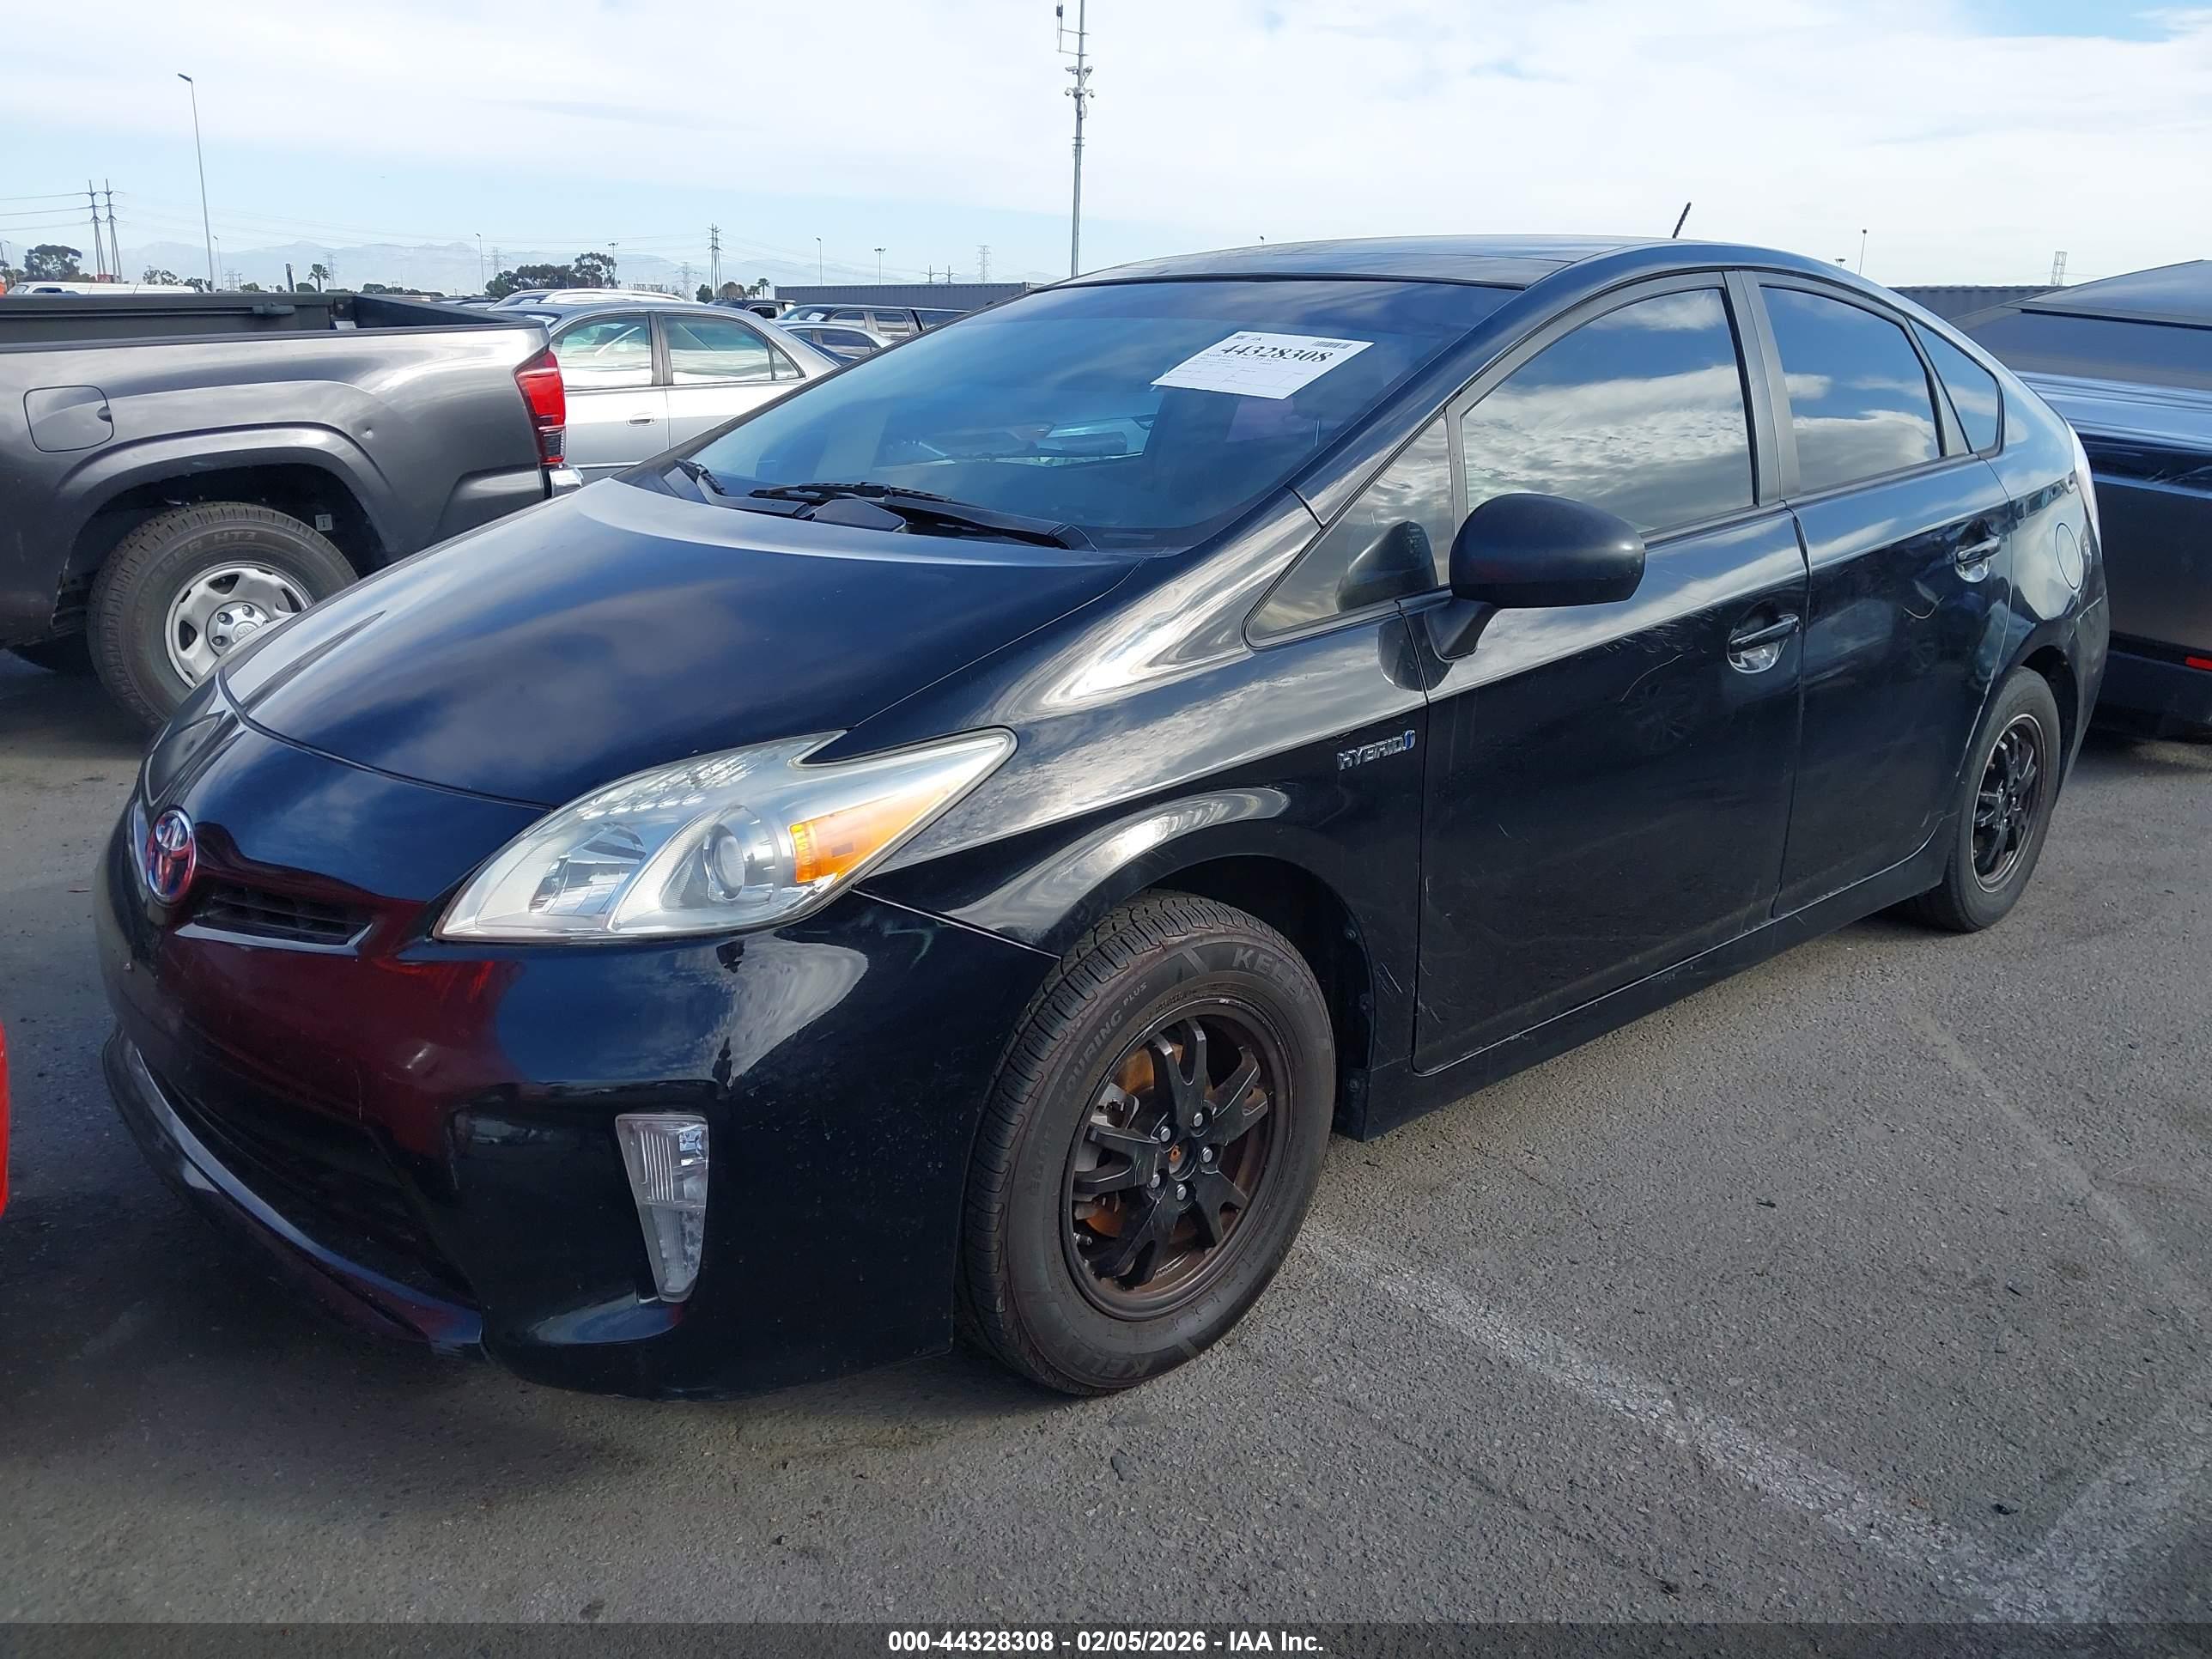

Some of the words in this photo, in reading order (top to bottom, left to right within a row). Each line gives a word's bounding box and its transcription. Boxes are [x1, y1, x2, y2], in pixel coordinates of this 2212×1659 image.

[1221, 343, 1334, 363] 44328308
[213, 530, 258, 543] HT3
[1336, 736, 1404, 771] HYBRID
[1231, 946, 1311, 1005] KELLY
[1056, 1009, 1123, 1107] TOURING
[1121, 981, 1147, 1006] PLUS
